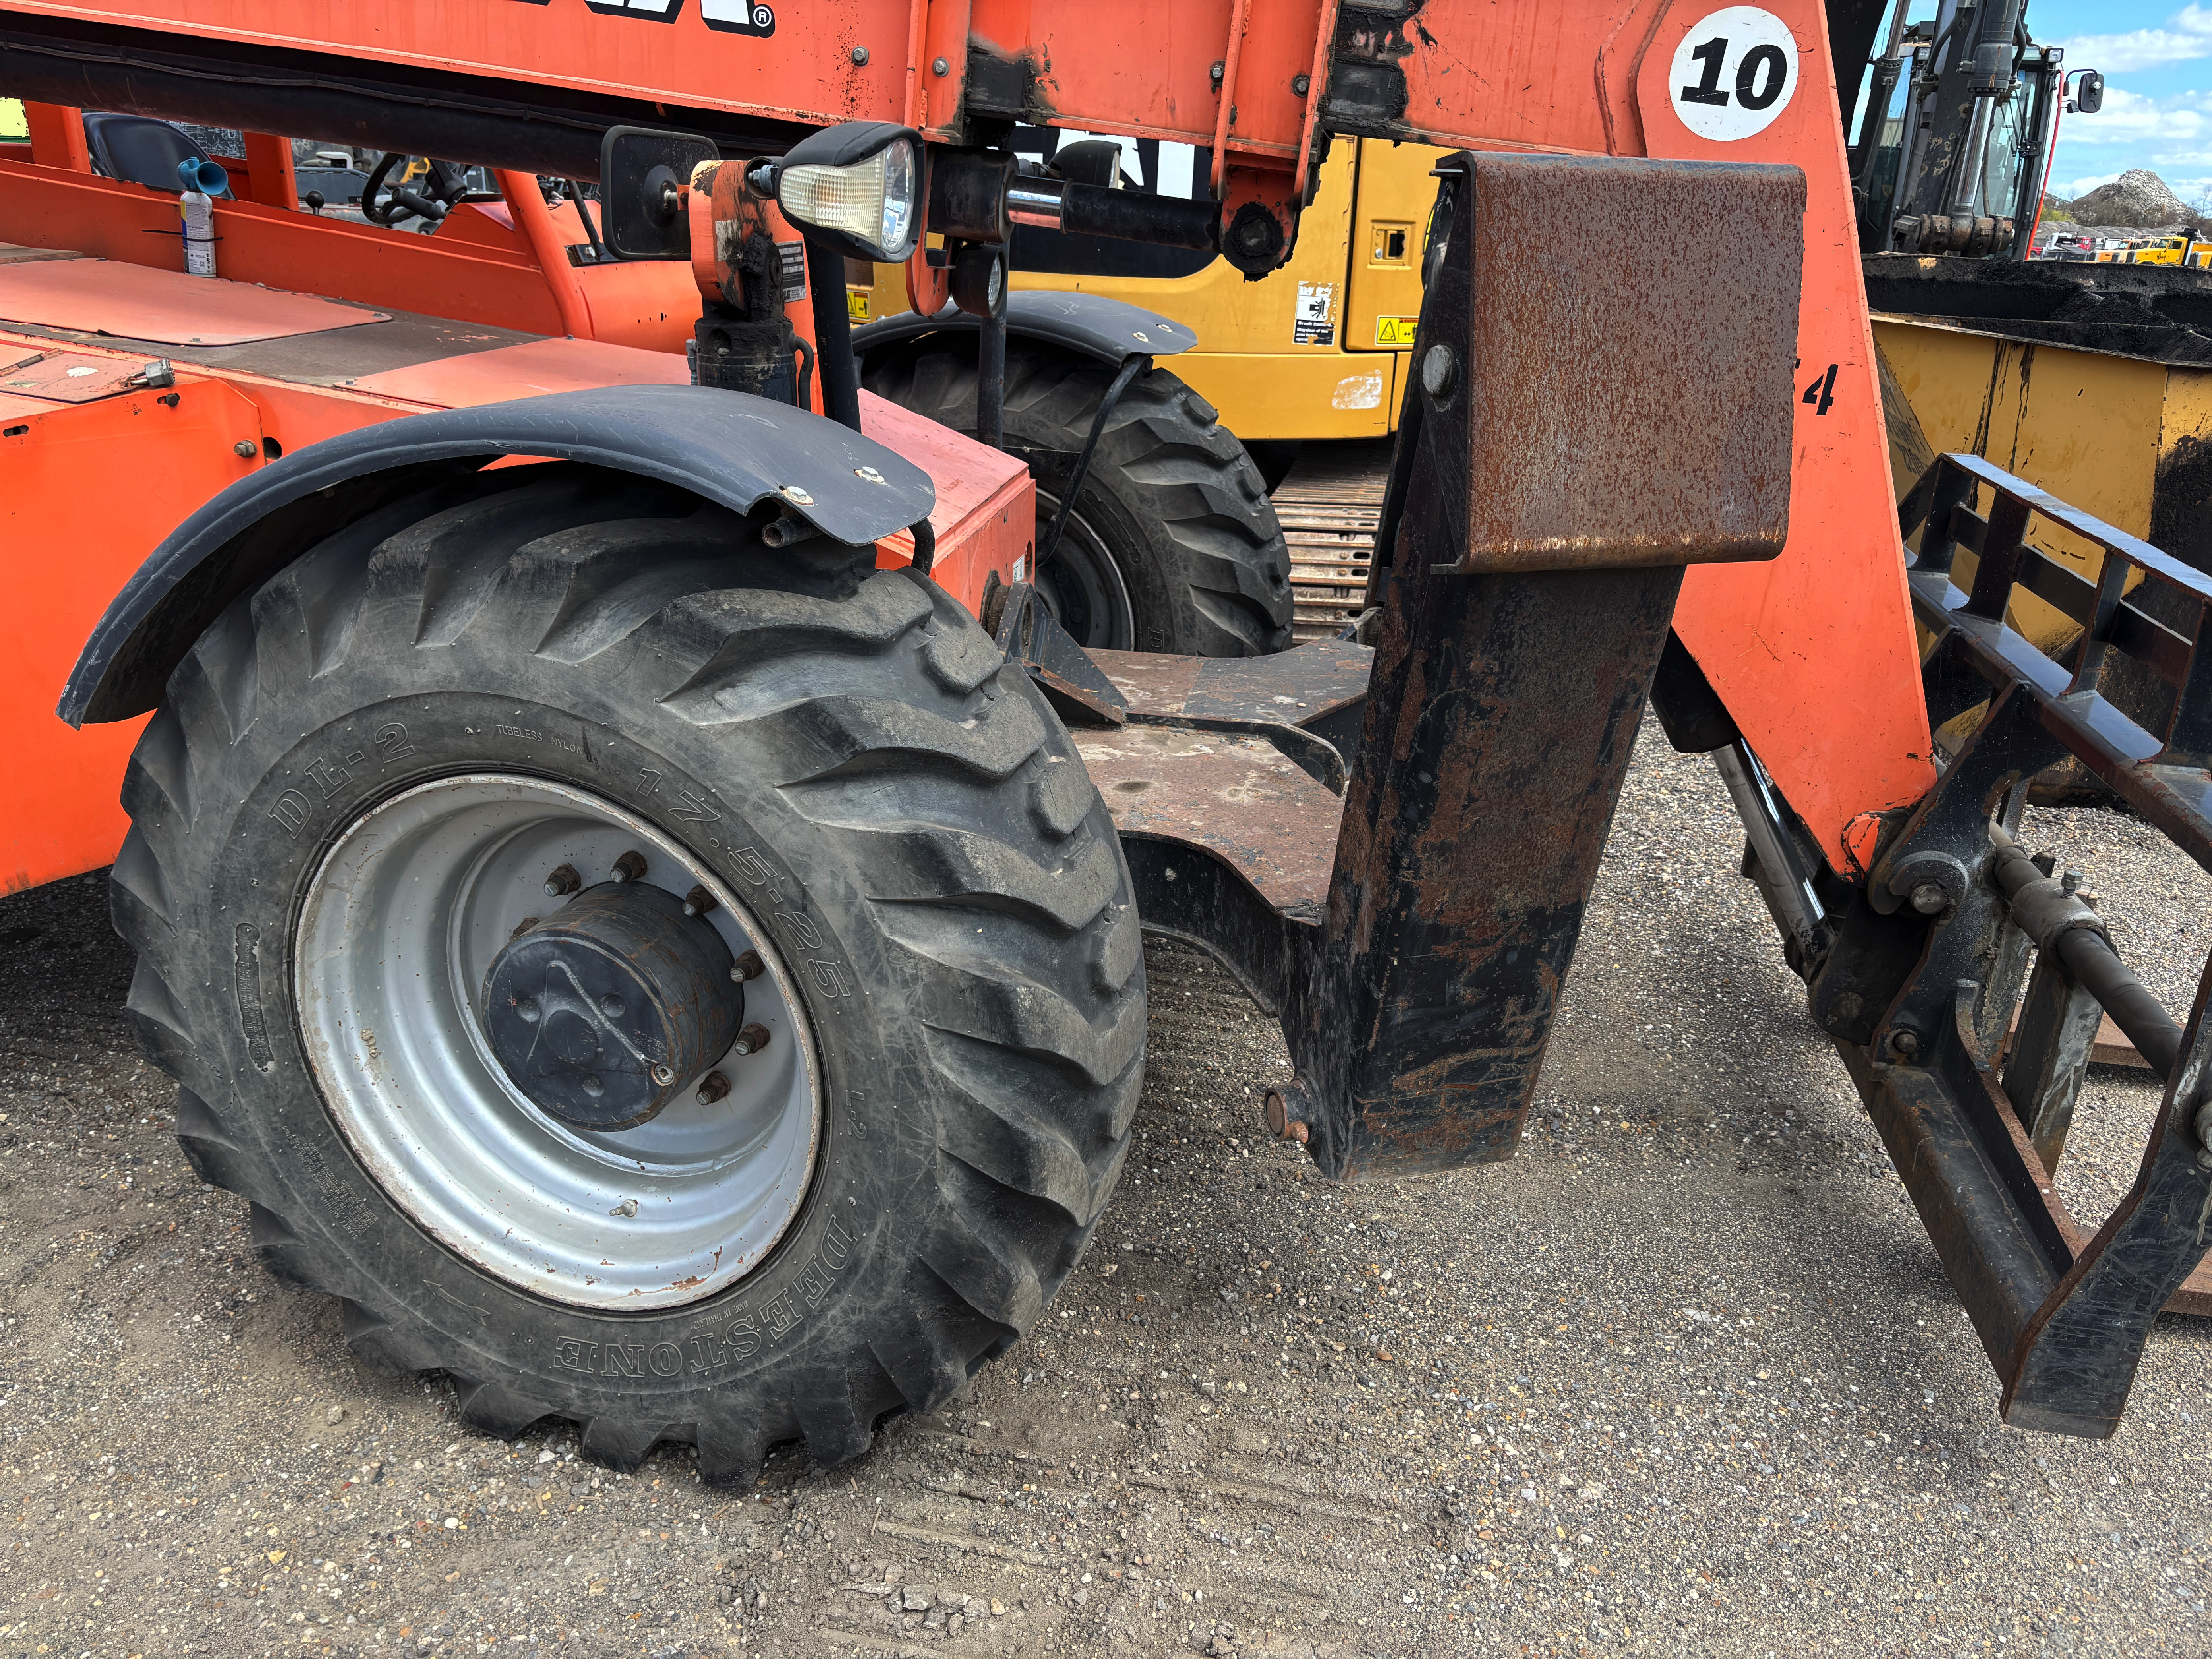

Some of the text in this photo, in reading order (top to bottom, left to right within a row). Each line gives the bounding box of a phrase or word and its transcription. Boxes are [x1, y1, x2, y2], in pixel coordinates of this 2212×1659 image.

[1680, 37, 1788, 111] 10
[1795, 358, 1839, 416] 4
[495, 724, 543, 742] TUBELESS
[267, 722, 416, 840] DL-2
[635, 767, 851, 998] 17.5-25
[845, 1089, 868, 1140] L-2
[553, 1214, 859, 1378] DEESTONE
